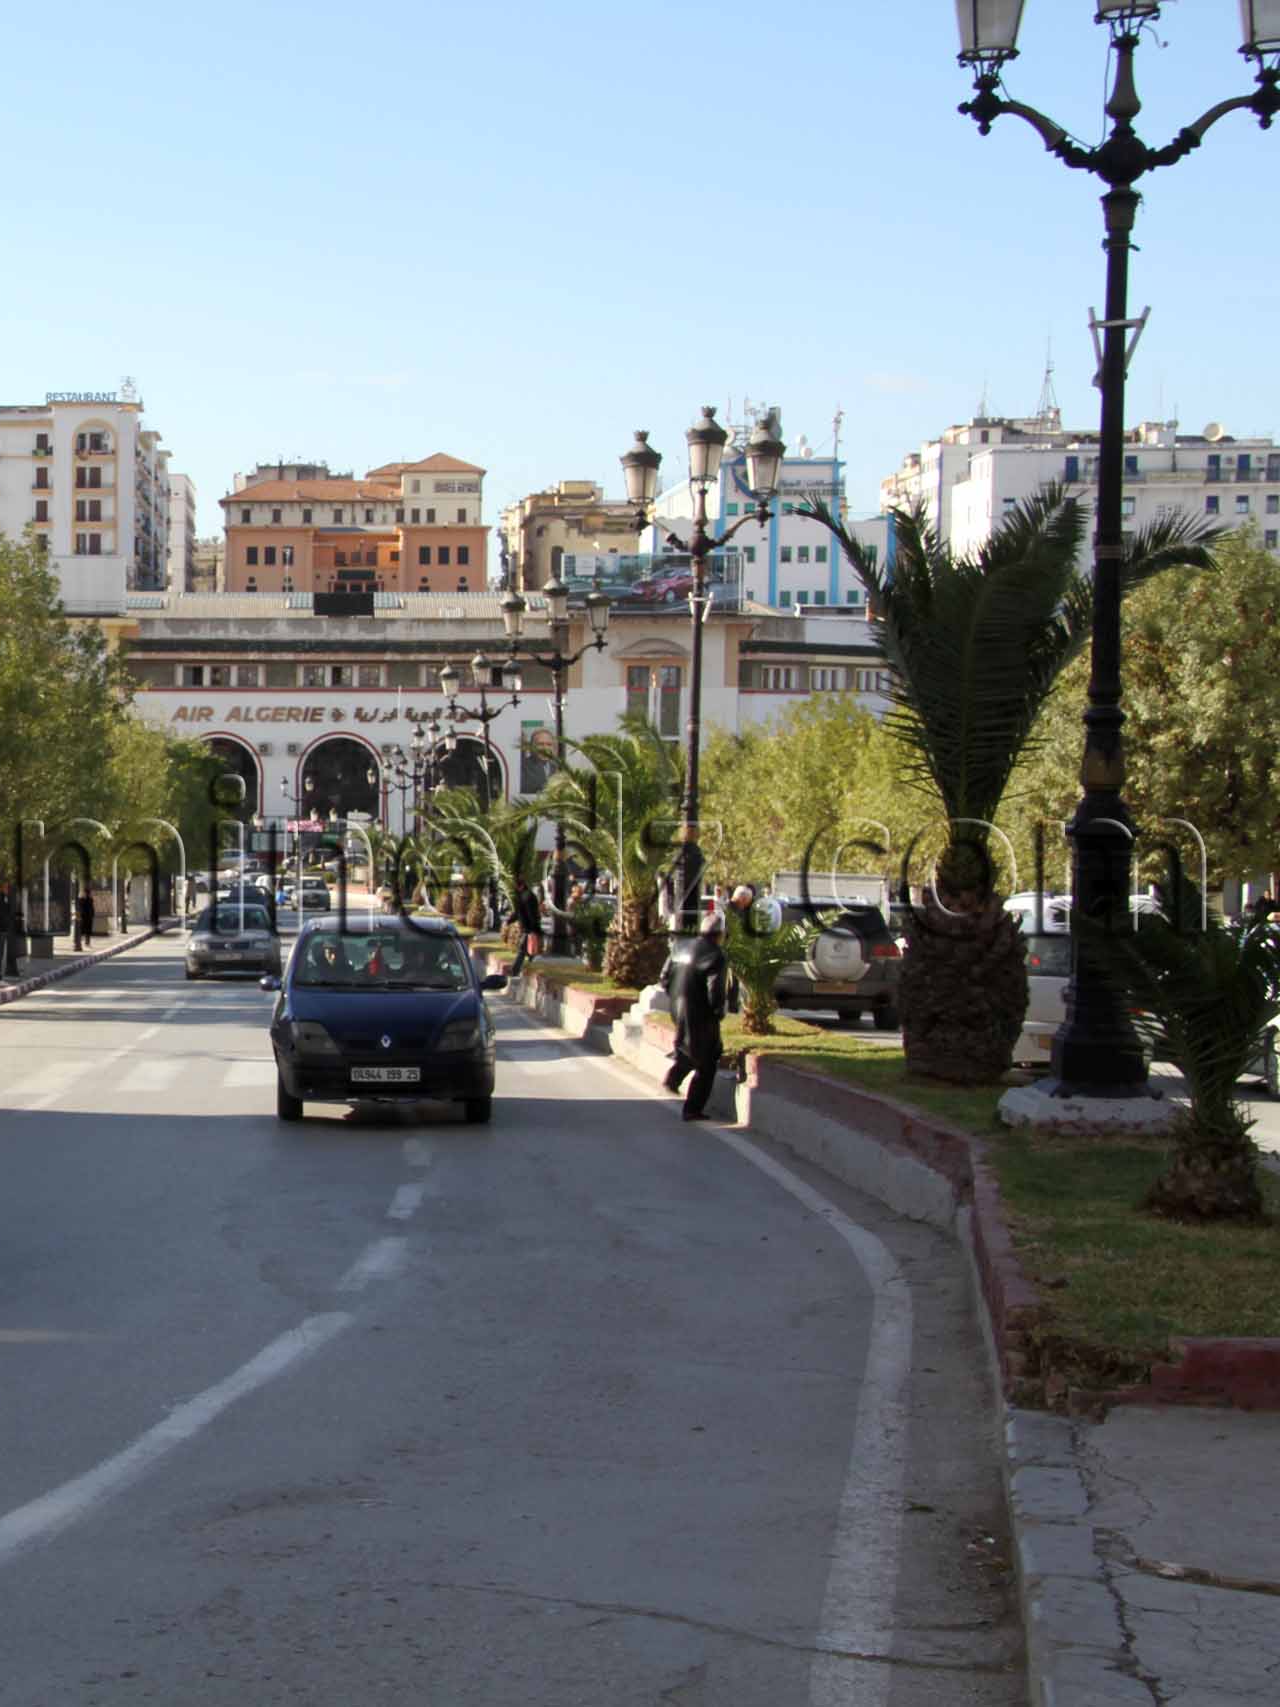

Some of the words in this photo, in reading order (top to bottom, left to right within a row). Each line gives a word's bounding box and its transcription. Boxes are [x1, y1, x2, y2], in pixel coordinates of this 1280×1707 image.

[46, 392, 118, 403] RESTAURANT
[171, 705, 215, 723] AIR
[224, 705, 325, 723] ALGERIE
